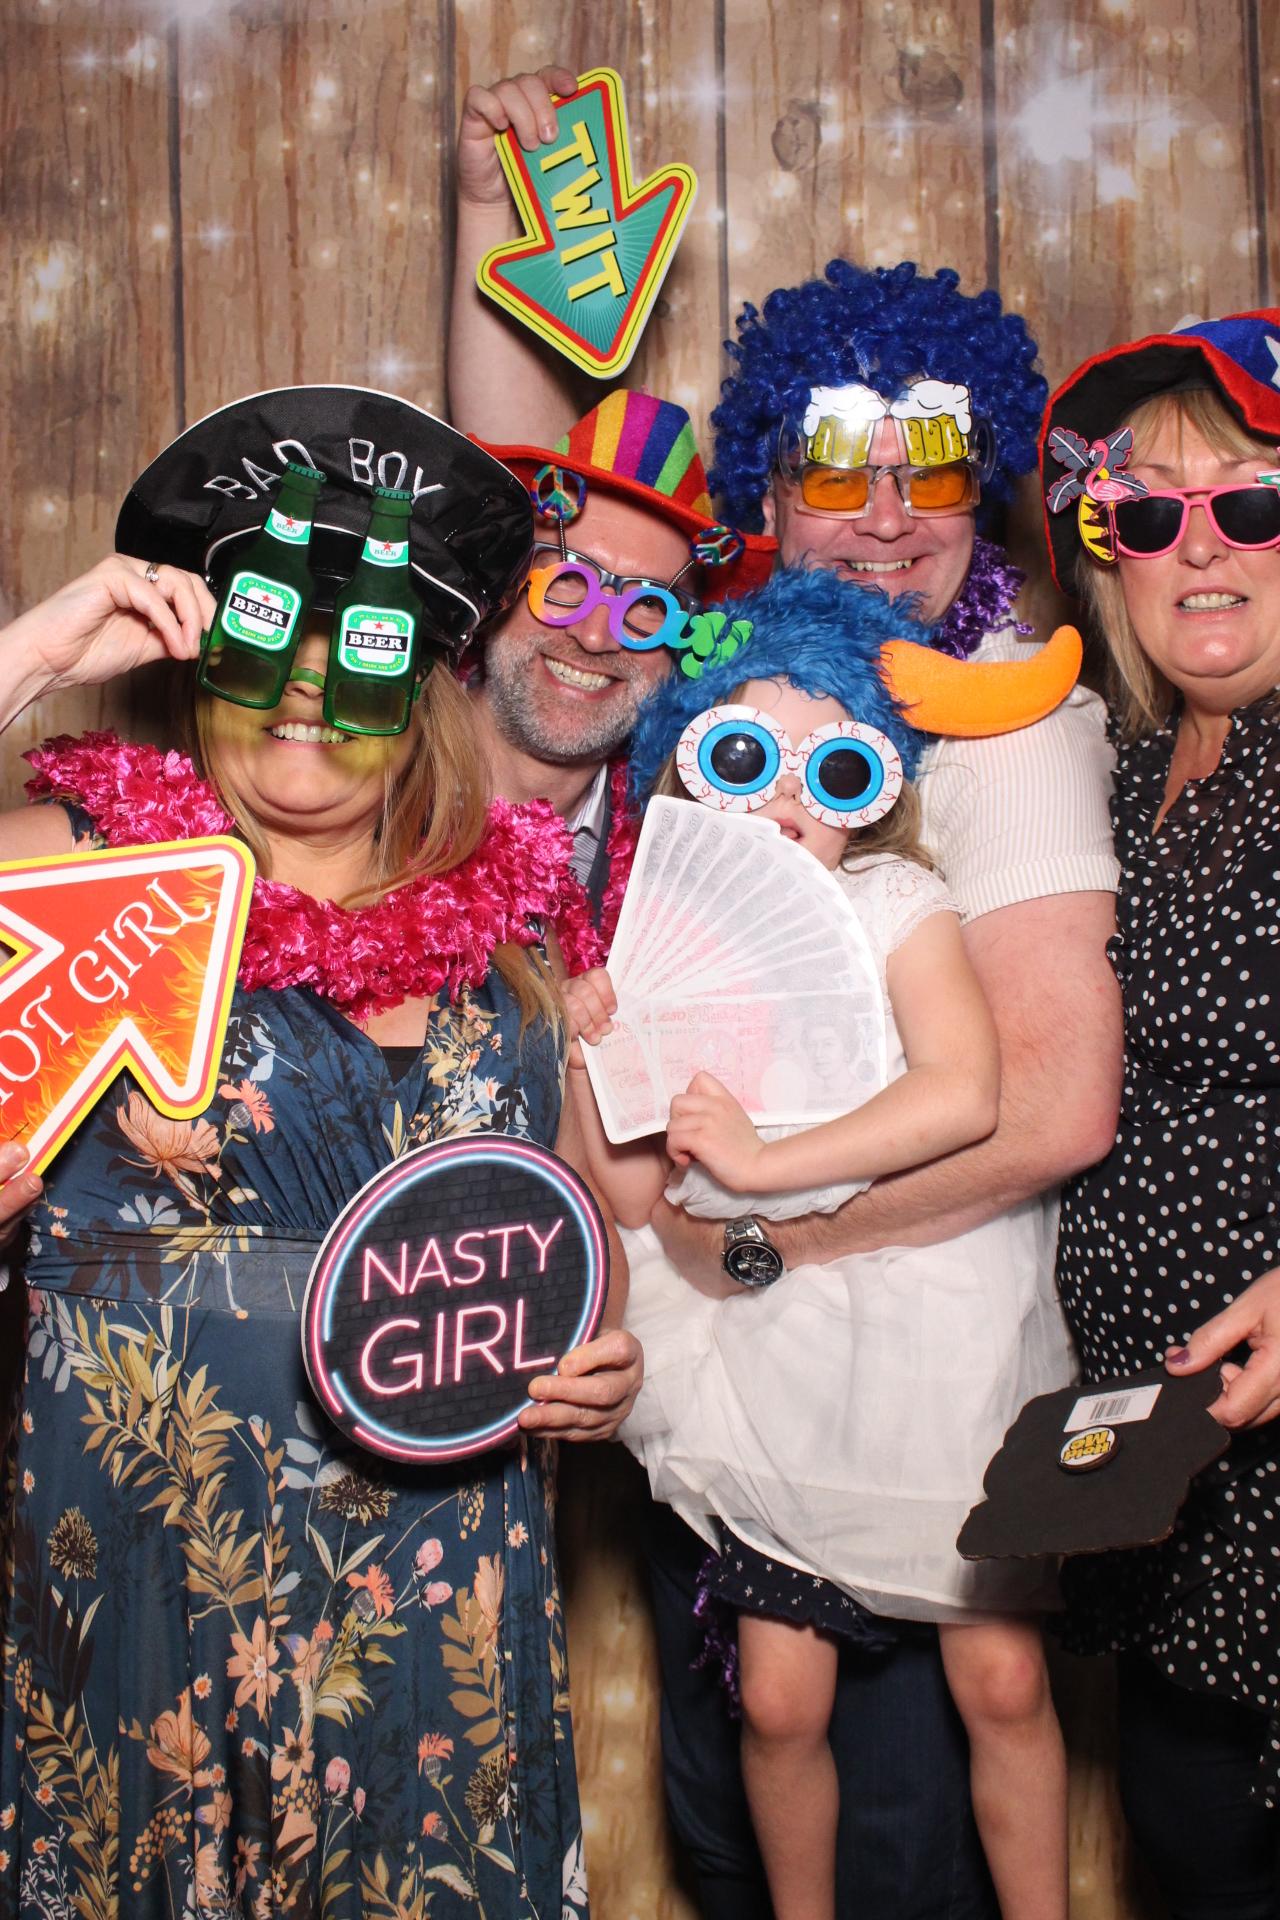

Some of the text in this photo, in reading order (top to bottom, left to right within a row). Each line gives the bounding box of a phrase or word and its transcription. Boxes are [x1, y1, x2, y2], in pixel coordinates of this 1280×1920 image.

[539, 120, 628, 303] TWIT
[349, 438, 446, 505] BOY
[373, 549, 397, 557] BEER
[232, 596, 284, 625] BEER
[348, 633, 403, 650] BEER
[0, 877, 213, 1105] OT GIRL
[361, 1218, 564, 1301] NASTY
[360, 1298, 556, 1395] GIRL
